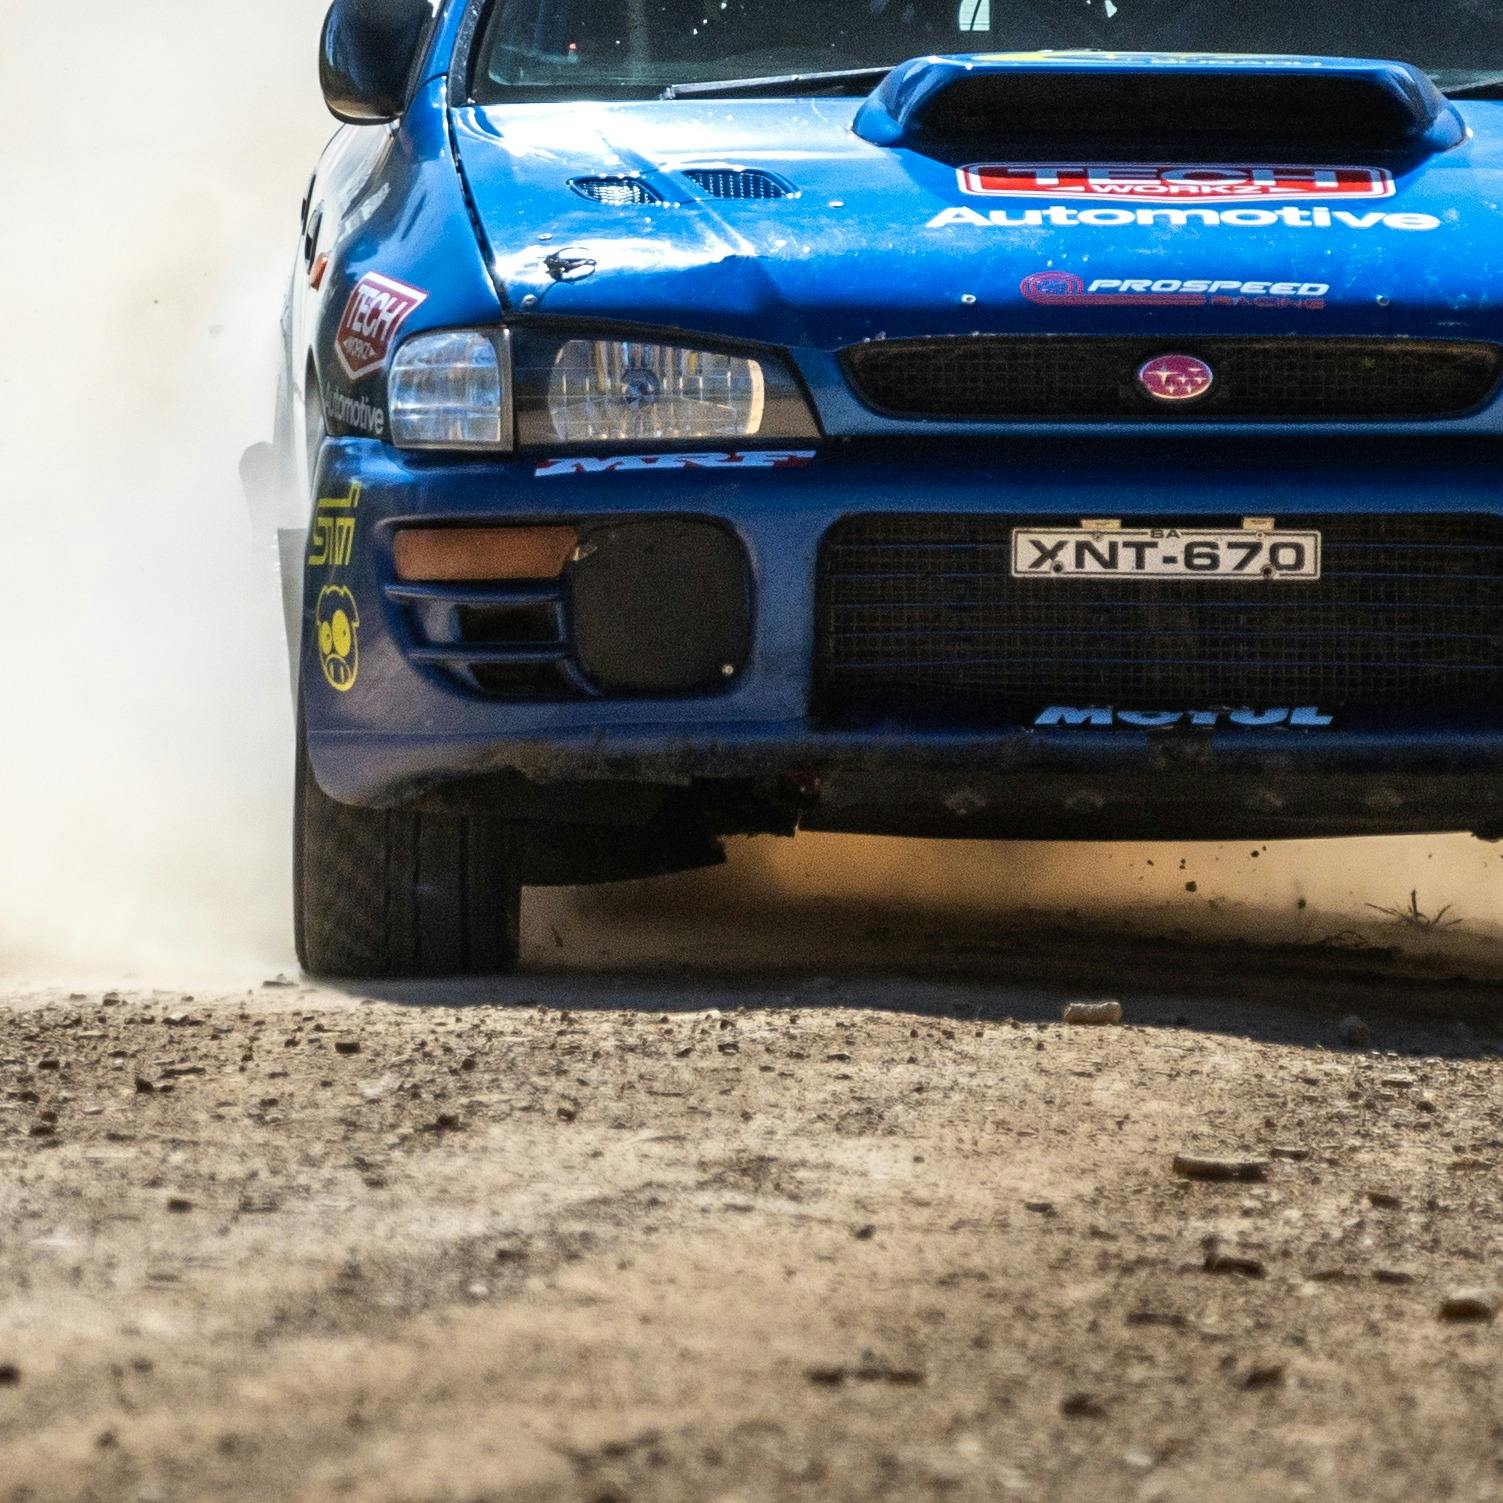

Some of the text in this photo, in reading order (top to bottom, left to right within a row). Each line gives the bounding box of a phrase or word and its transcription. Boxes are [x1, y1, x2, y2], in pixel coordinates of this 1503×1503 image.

[1007, 167, 1339, 188] TECH
[1089, 183, 1264, 194] WORKZ
[925, 205, 1442, 232] Automotive
[1087, 278, 1330, 296] PROSPEED
[346, 283, 408, 342] TECH
[1028, 539, 1306, 572] XNT-670
[1033, 704, 1334, 726] MOTUL
